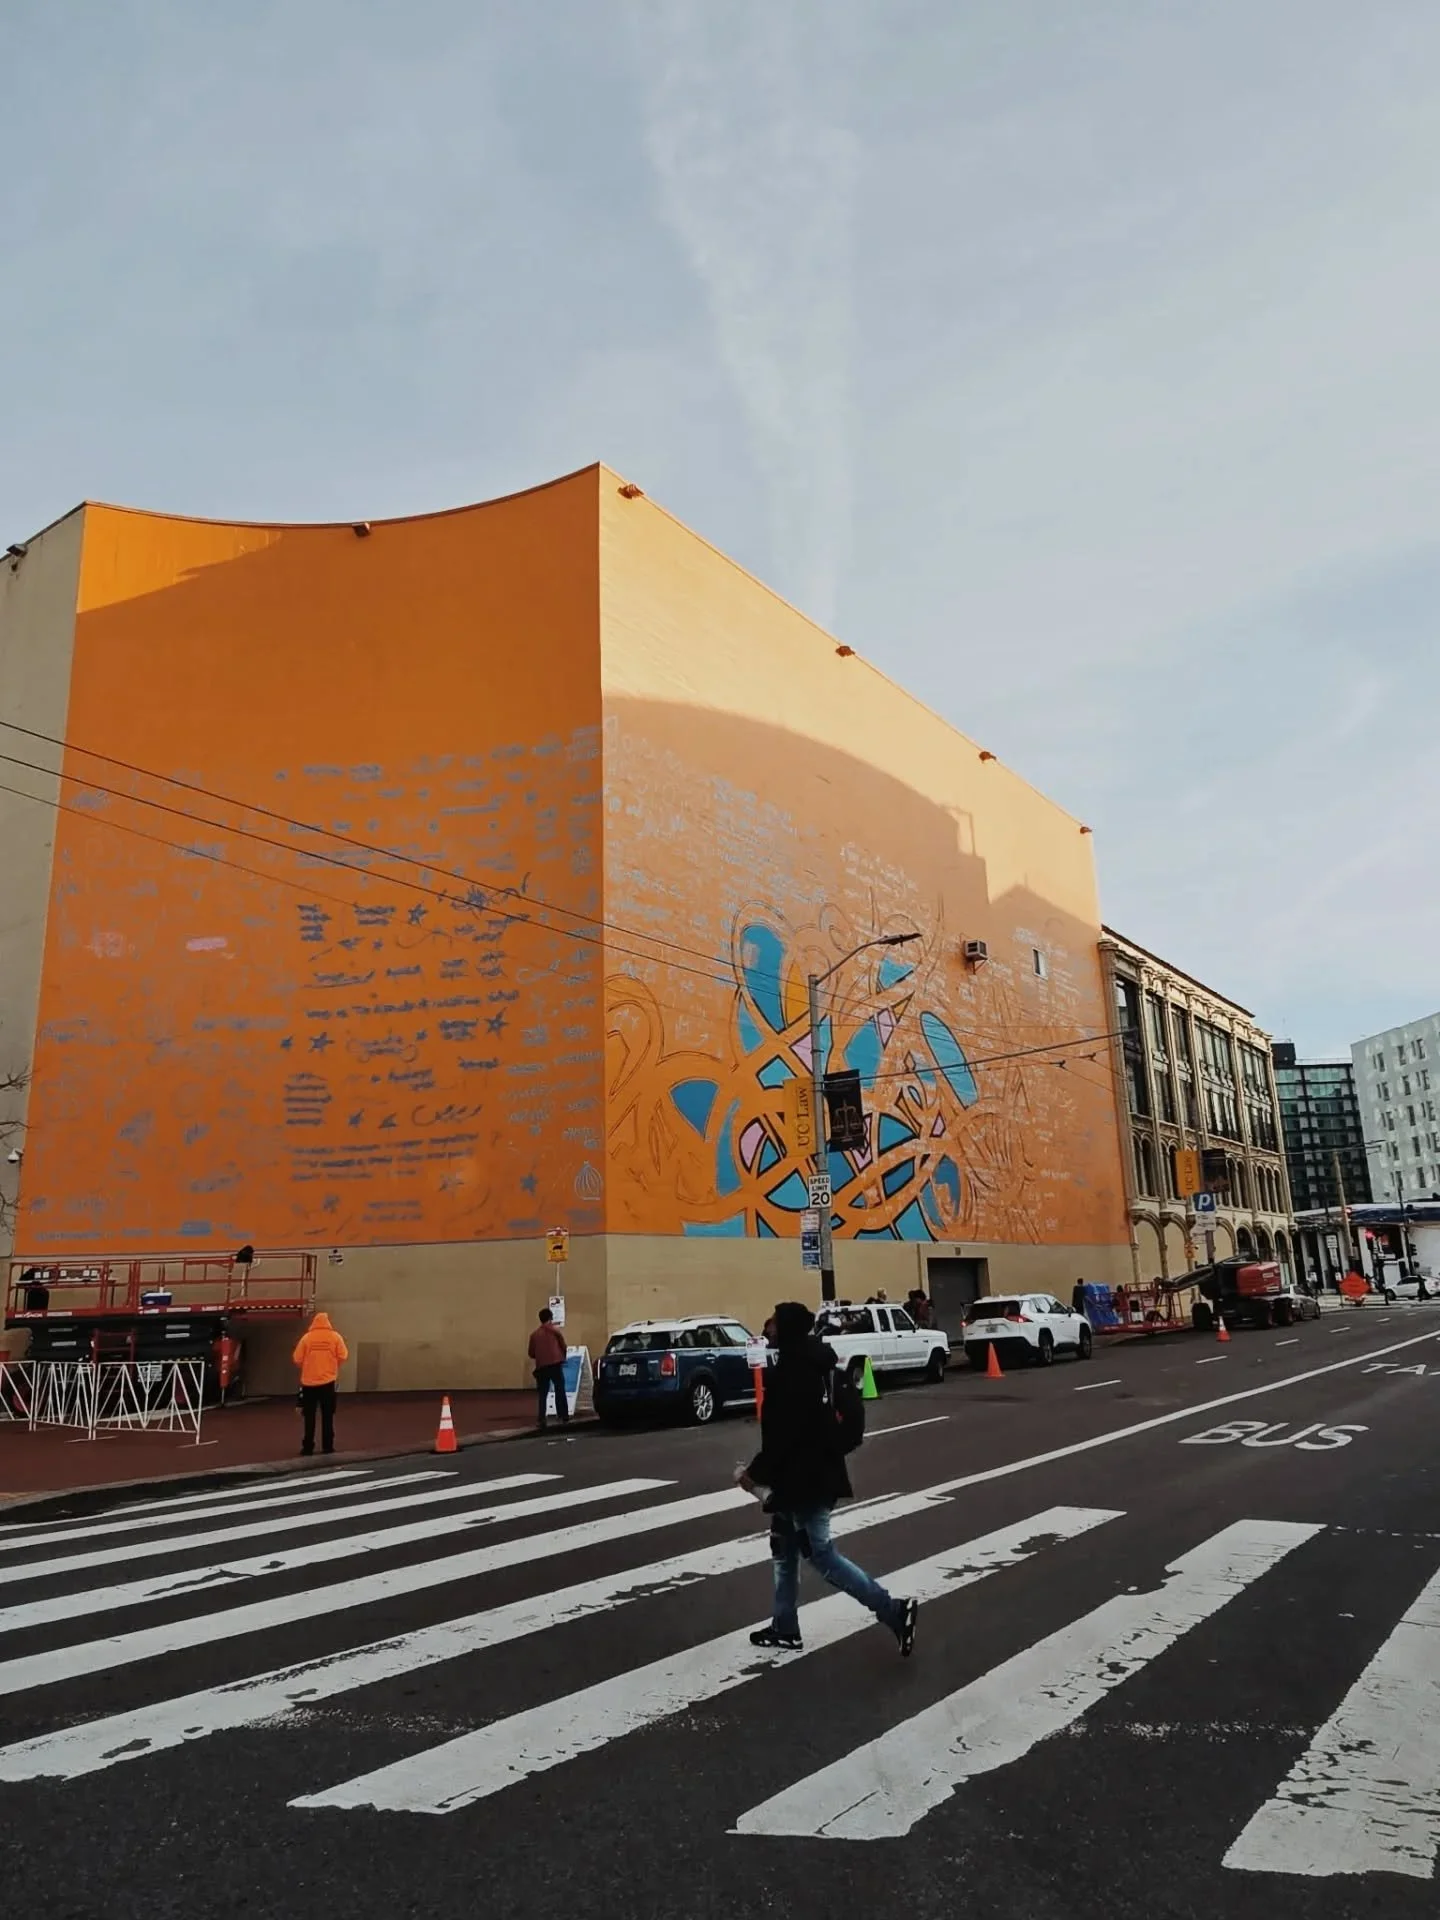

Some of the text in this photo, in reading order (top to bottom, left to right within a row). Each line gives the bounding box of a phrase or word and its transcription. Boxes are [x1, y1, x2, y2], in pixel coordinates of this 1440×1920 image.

[797, 1088, 810, 1147] UC Law
[811, 1192, 830, 1205] 20
[1198, 1194, 1211, 1210] P
[1178, 1421, 1370, 1450] BUS
